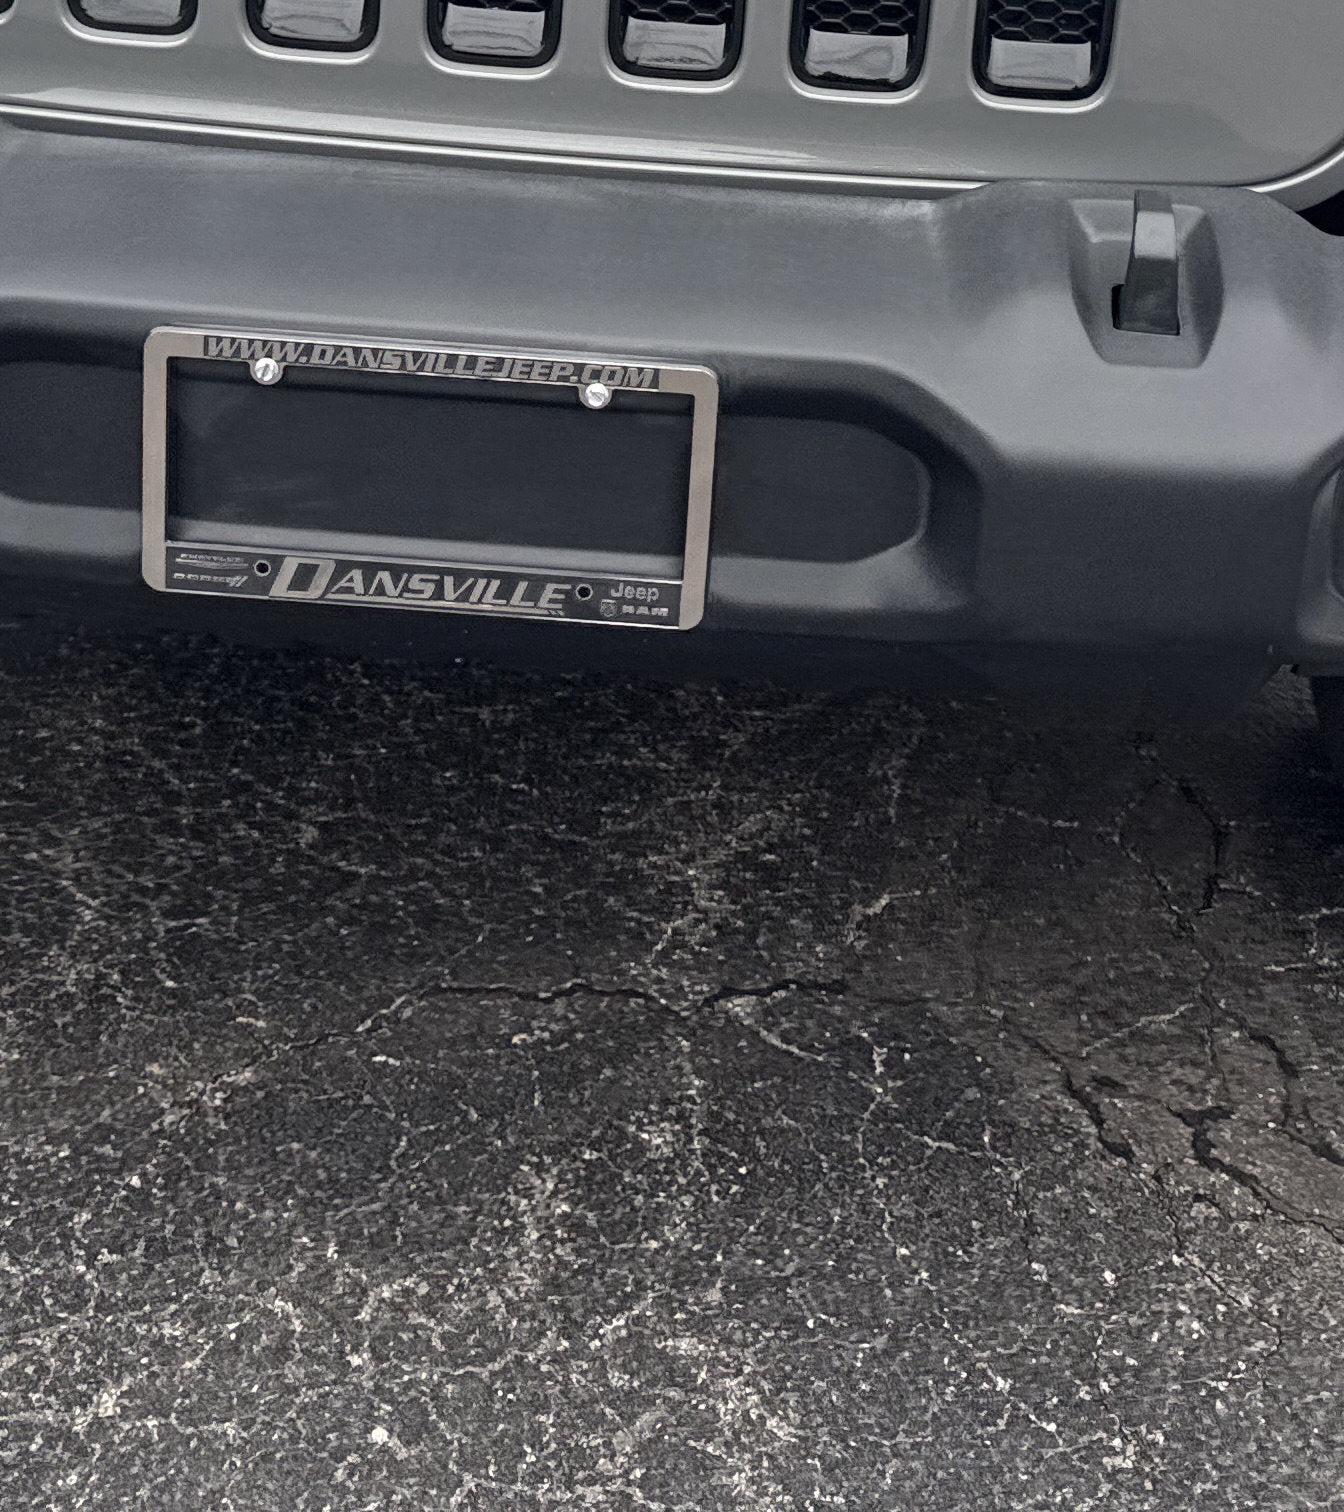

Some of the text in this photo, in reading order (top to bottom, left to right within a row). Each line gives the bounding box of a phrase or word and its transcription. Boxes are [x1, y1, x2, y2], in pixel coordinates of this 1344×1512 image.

[206, 337, 655, 388] WWW.DANSVILLEJEEP.COM
[269, 555, 571, 609] DANSVILLE
[611, 582, 659, 602] Jeep
[622, 604, 669, 617] RAM
